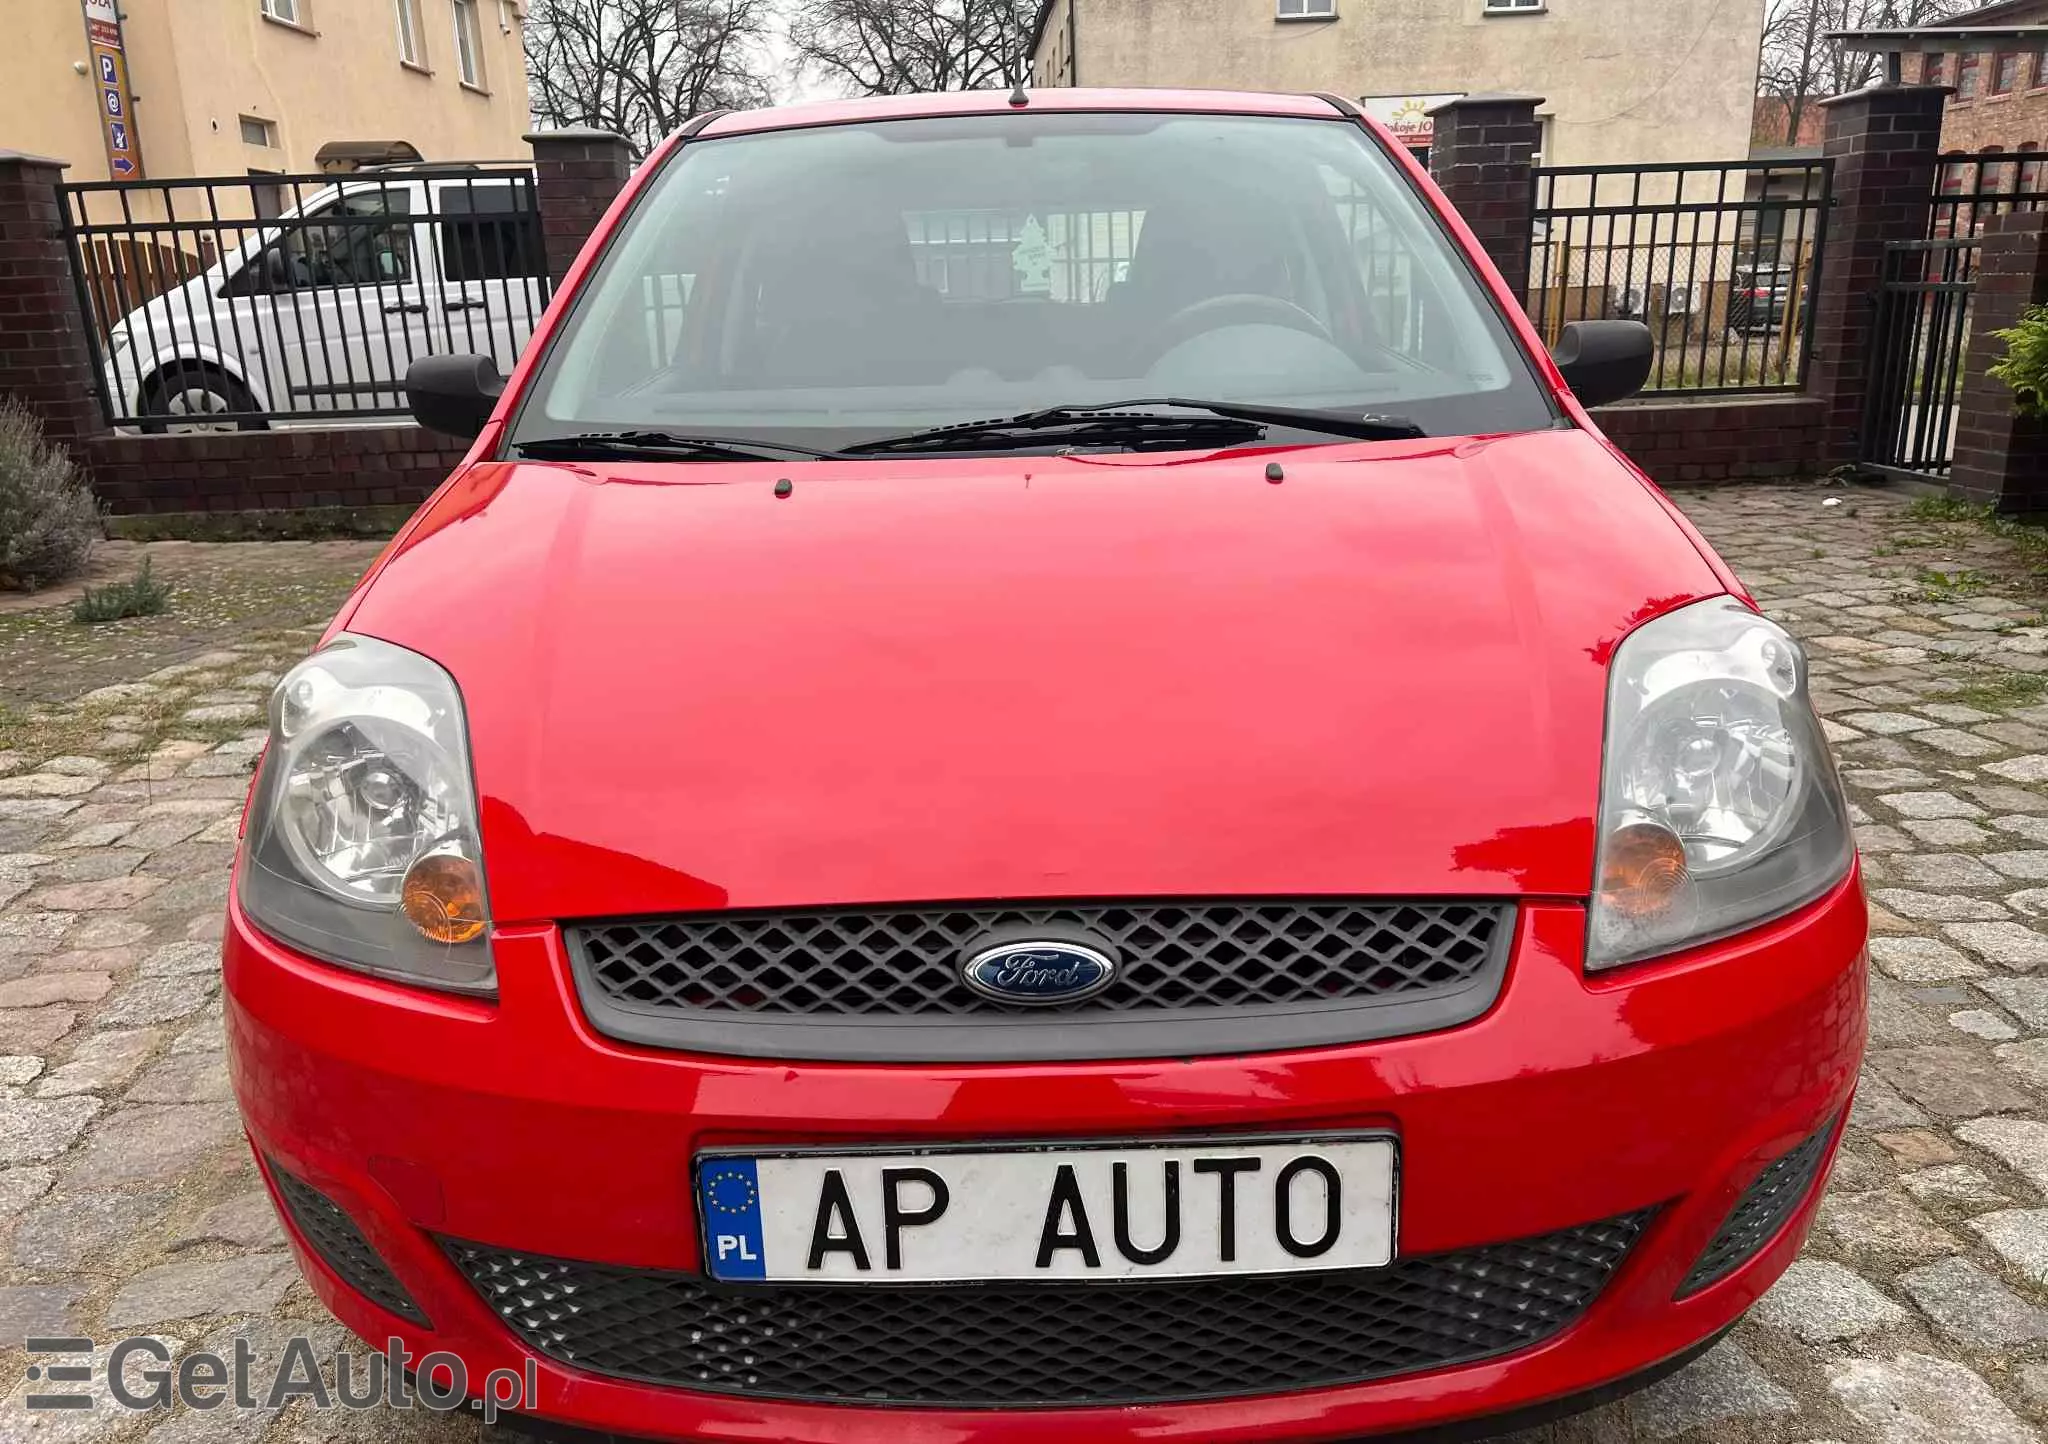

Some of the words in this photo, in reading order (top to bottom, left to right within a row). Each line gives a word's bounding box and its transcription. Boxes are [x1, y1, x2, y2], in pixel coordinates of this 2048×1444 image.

[997, 953, 1079, 986] Ford
[807, 1167, 950, 1270] AP
[1035, 1155, 1342, 1268] AUTO
[717, 1234, 757, 1260] PL
